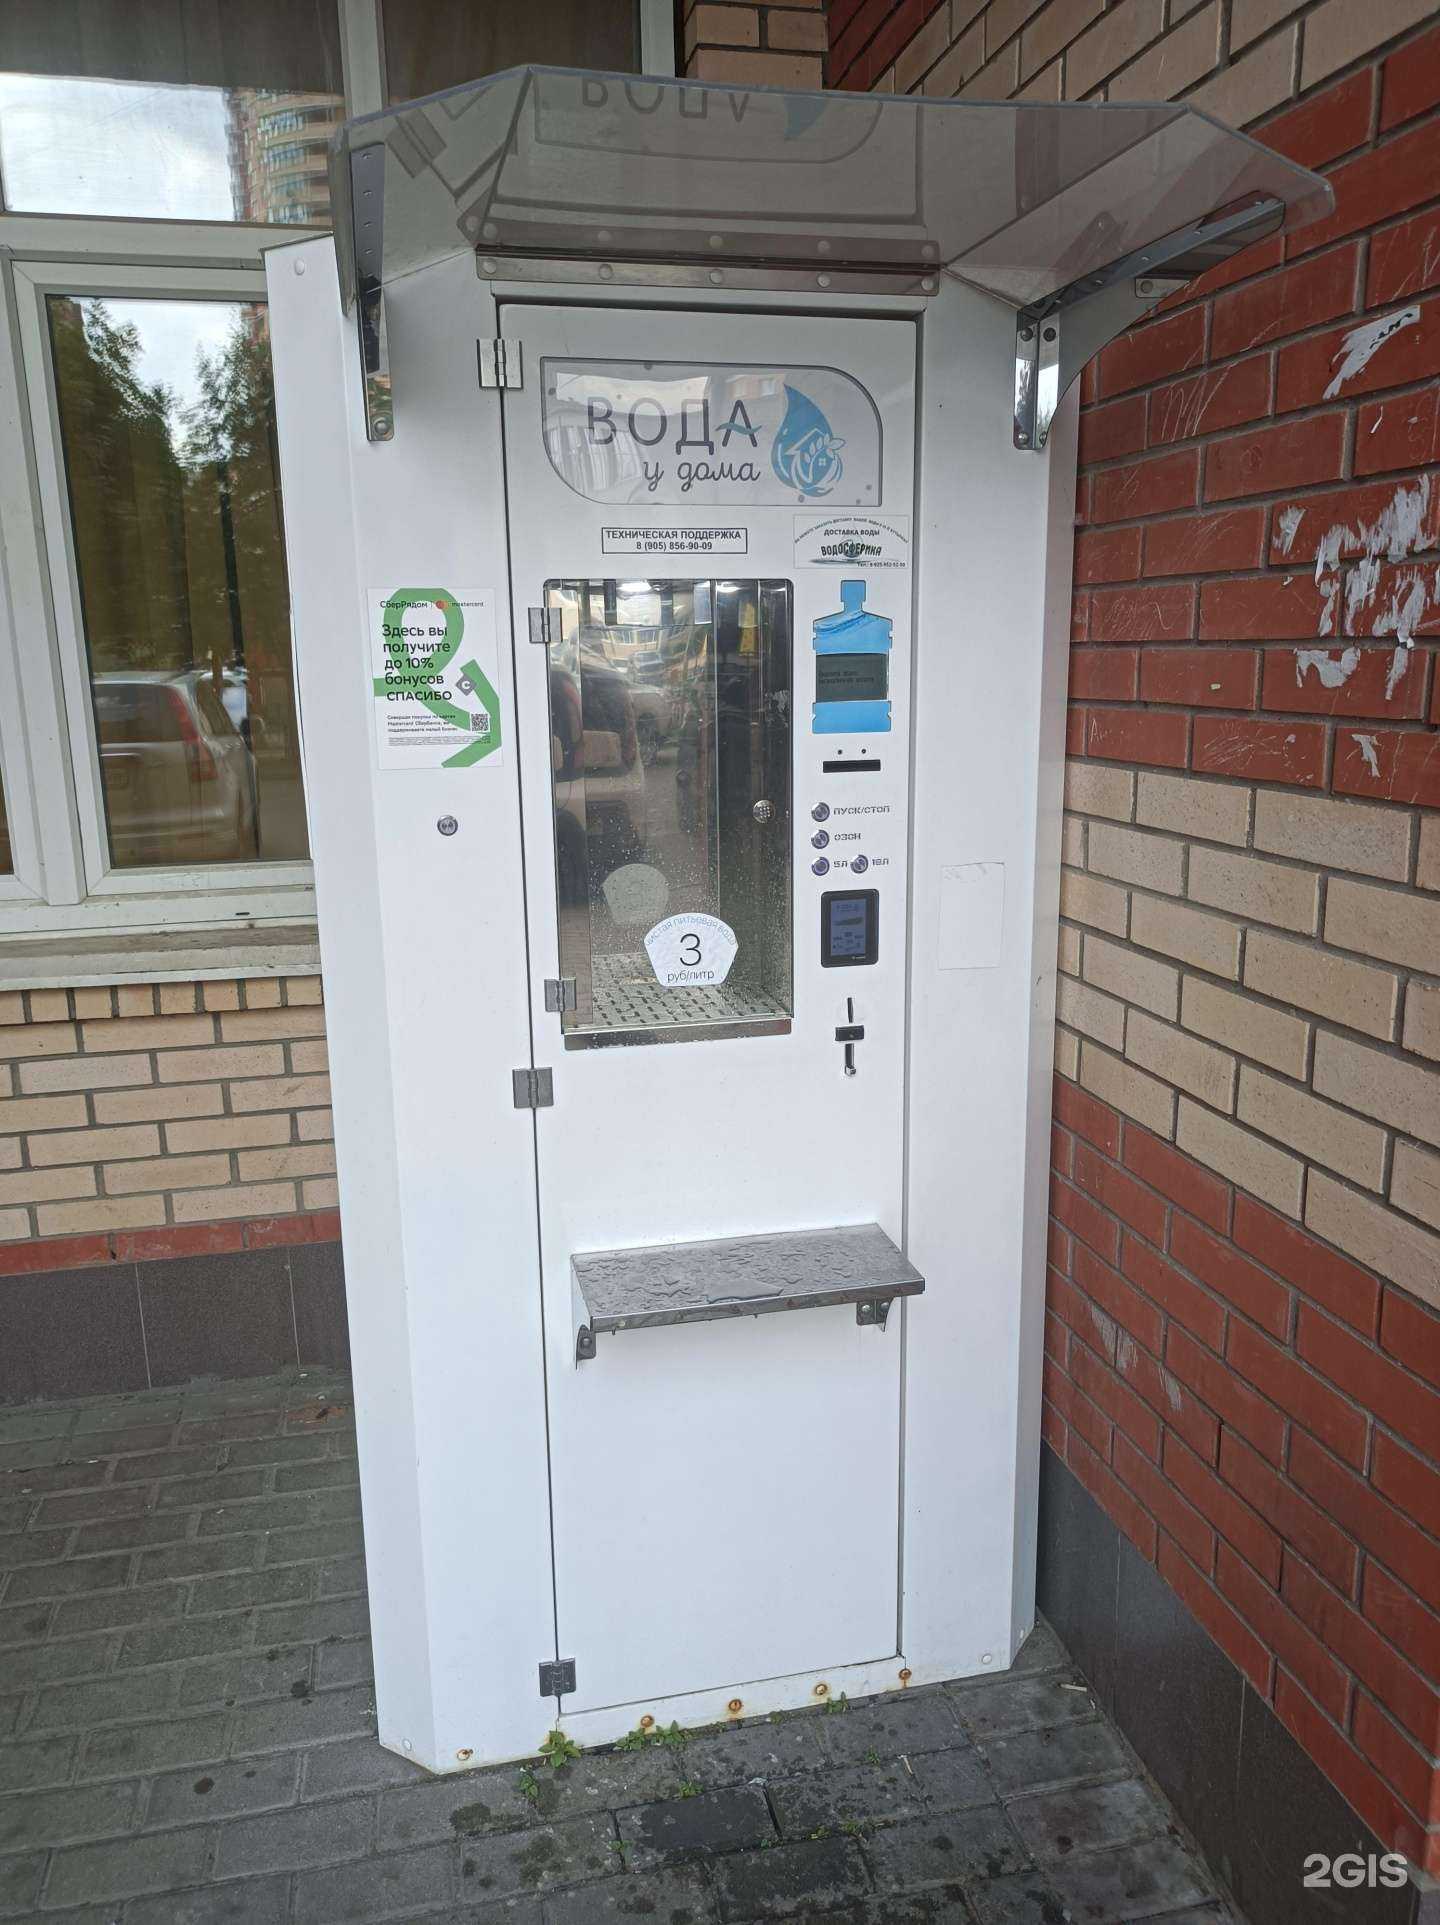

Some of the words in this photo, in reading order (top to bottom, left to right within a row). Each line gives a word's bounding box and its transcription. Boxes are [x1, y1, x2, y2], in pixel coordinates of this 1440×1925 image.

[587, 396, 762, 455] ВОДА
[643, 461, 664, 492] у
[677, 460, 761, 492] дома
[605, 530, 678, 540] ТЕХНИЧЕСКАЯ
[681, 530, 742, 541] ПОДДЕРЖКА
[824, 529, 859, 537] ДОСТАВКА
[861, 529, 880, 537] ВОДЫ
[636, 541, 642, 550] 8
[644, 541, 667, 551] (905)
[669, 541, 713, 550] 856-90-09
[380, 600, 428, 610] СберРядом
[382, 623, 425, 637] Здесь
[429, 626, 448, 637] вы
[383, 642, 451, 654] получите
[385, 659, 403, 671] до
[406, 657, 434, 669] 10%
[385, 671, 444, 688] бонусов
[386, 690, 452, 702] СПАСИБО
[833, 805, 890, 816] ПУСК/СТОП
[834, 832, 862, 841] ОЗОН
[680, 933, 702, 966] 3
[667, 969, 715, 983] руб/литр
